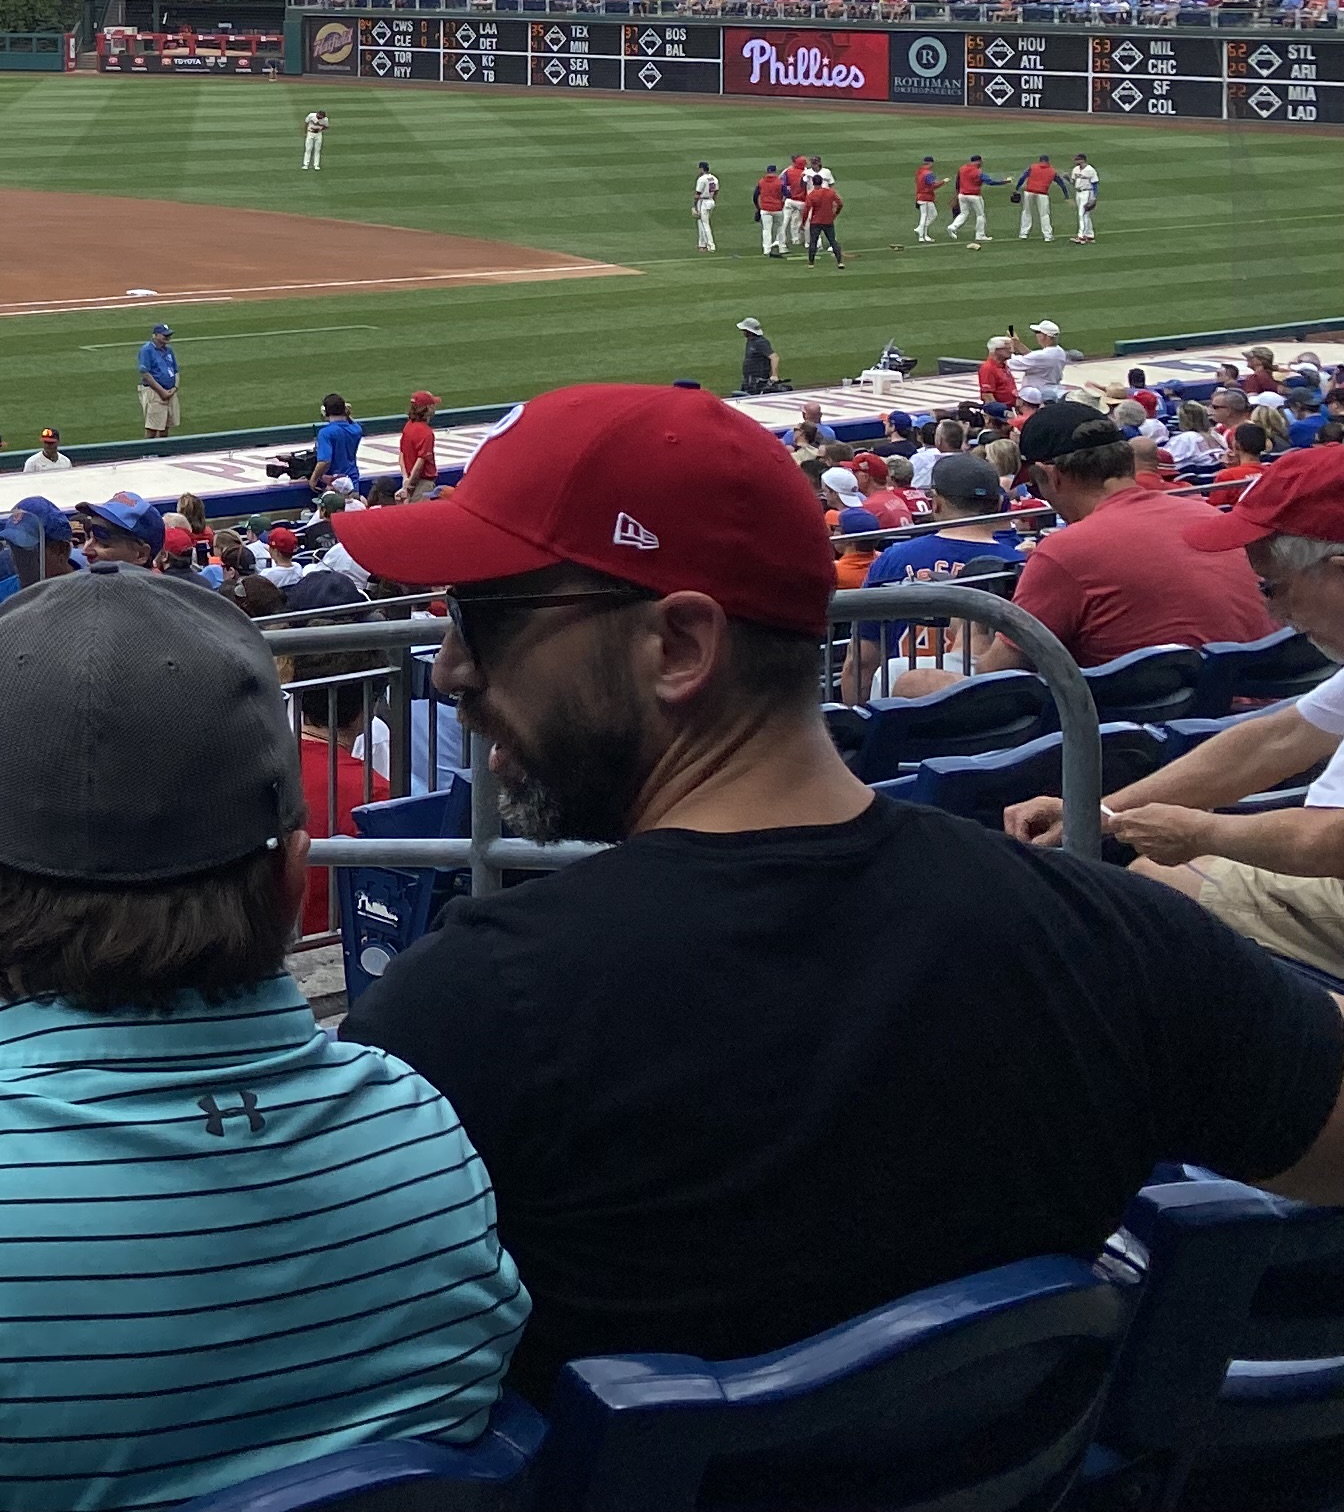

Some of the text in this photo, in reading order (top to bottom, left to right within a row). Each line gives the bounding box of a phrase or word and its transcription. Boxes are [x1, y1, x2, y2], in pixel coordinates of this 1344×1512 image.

[393, 20, 413, 31] CWS
[480, 23, 497, 35] LAA
[571, 26, 588, 38] TEX
[666, 28, 687, 40] BOS
[395, 35, 411, 47] CLE
[480, 38, 497, 50] DET
[570, 41, 588, 53] MIN
[1018, 38, 1046, 52] HOU
[666, 44, 686, 57] BAL
[1150, 41, 1175, 55] MIL
[1288, 44, 1316, 59] STL
[174, 58, 202, 66] TOYOTA
[394, 52, 412, 63] TOR
[482, 55, 495, 67] KC
[742, 38, 865, 88] Phillies
[921, 50, 935, 64] R
[1021, 55, 1044, 70] ATL
[570, 59, 589, 71] SEA
[1148, 59, 1177, 74] CHC
[394, 67, 412, 78] NYY
[482, 70, 495, 82] TB
[1291, 64, 1317, 79] ARI
[569, 74, 589, 86] OAK
[894, 77, 962, 89] ROTHMAN
[1021, 76, 1043, 89] CIN
[1153, 81, 1170, 95] SF
[1288, 86, 1316, 101] MIA
[1021, 94, 1042, 108] PIT
[1148, 99, 1176, 115] COL
[1287, 106, 1317, 121] LAD
